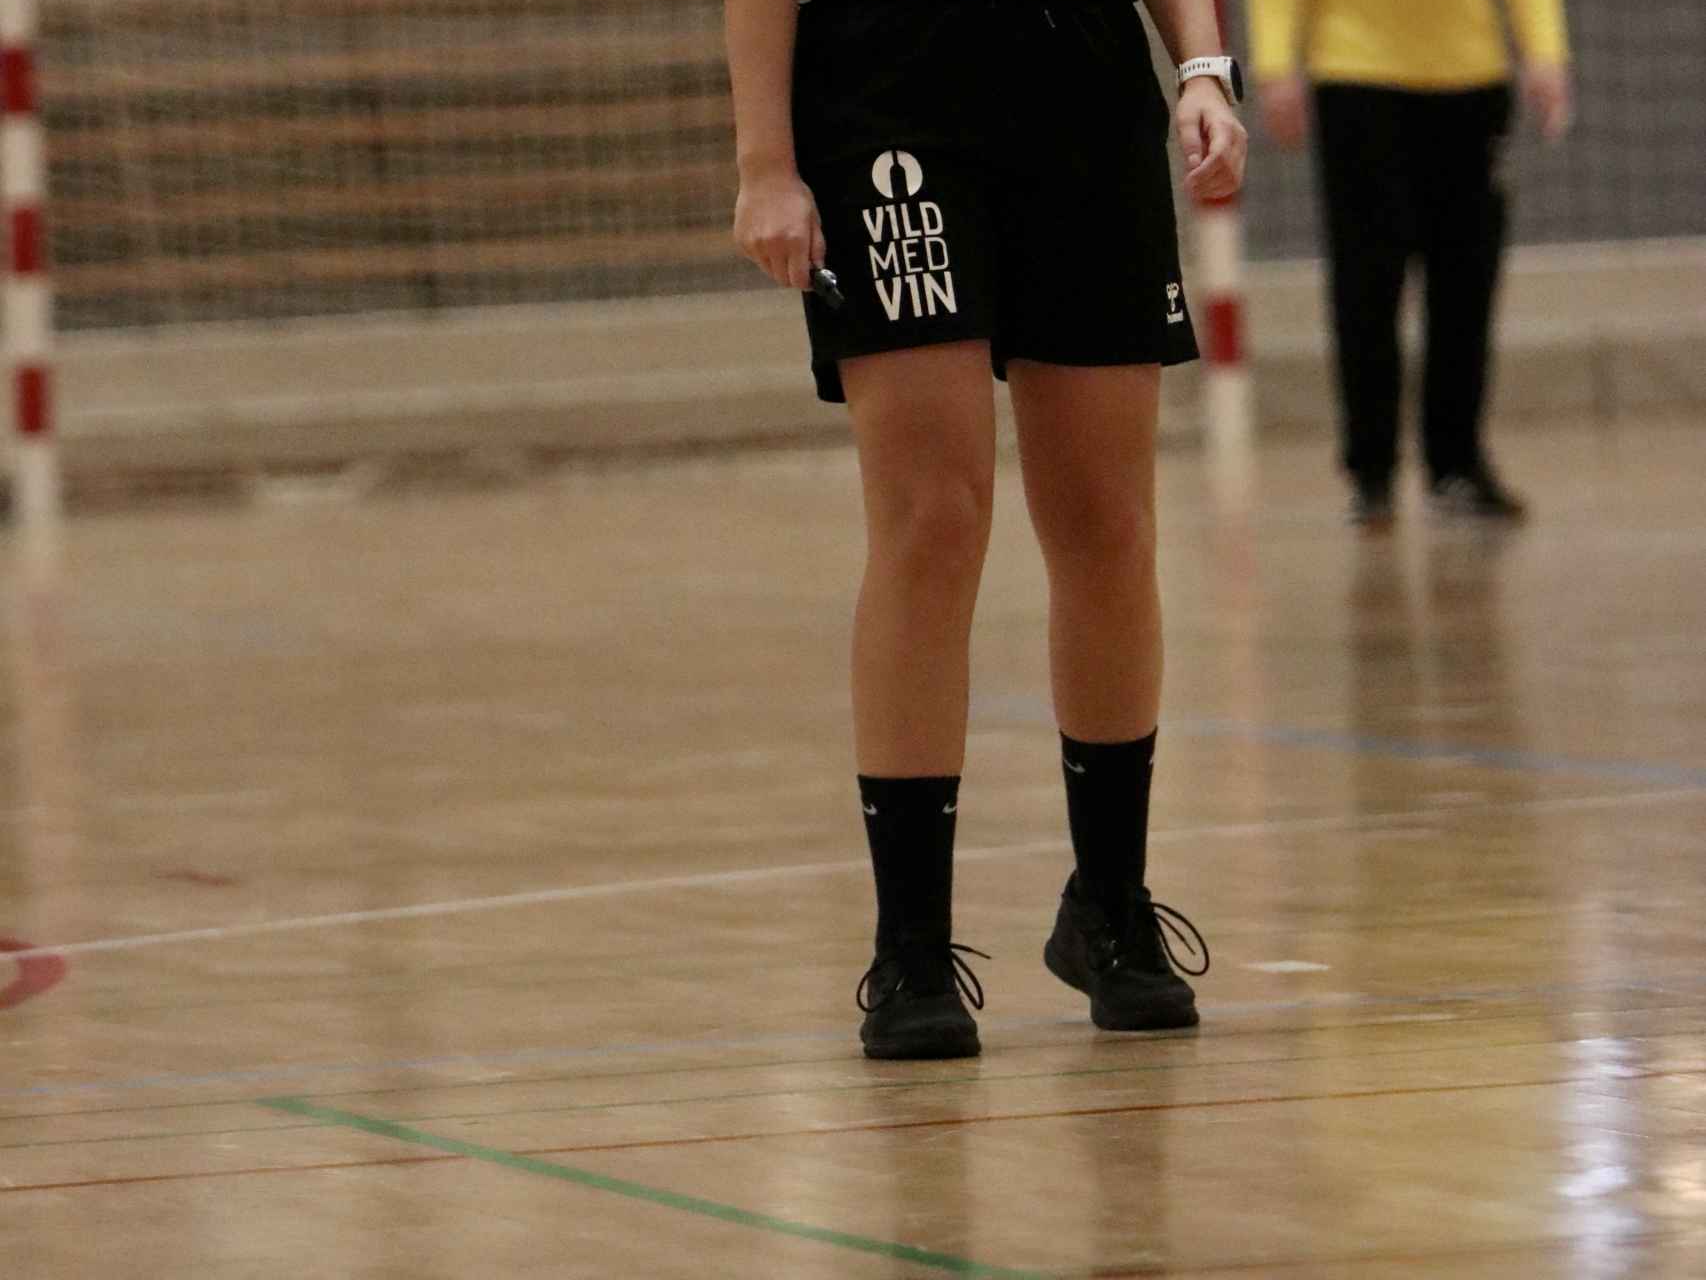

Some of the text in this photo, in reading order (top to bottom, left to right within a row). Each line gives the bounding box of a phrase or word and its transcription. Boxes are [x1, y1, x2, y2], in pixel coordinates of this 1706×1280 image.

[862, 201, 943, 243] VILD
[868, 236, 949, 279] MED
[875, 271, 957, 322] VIN
